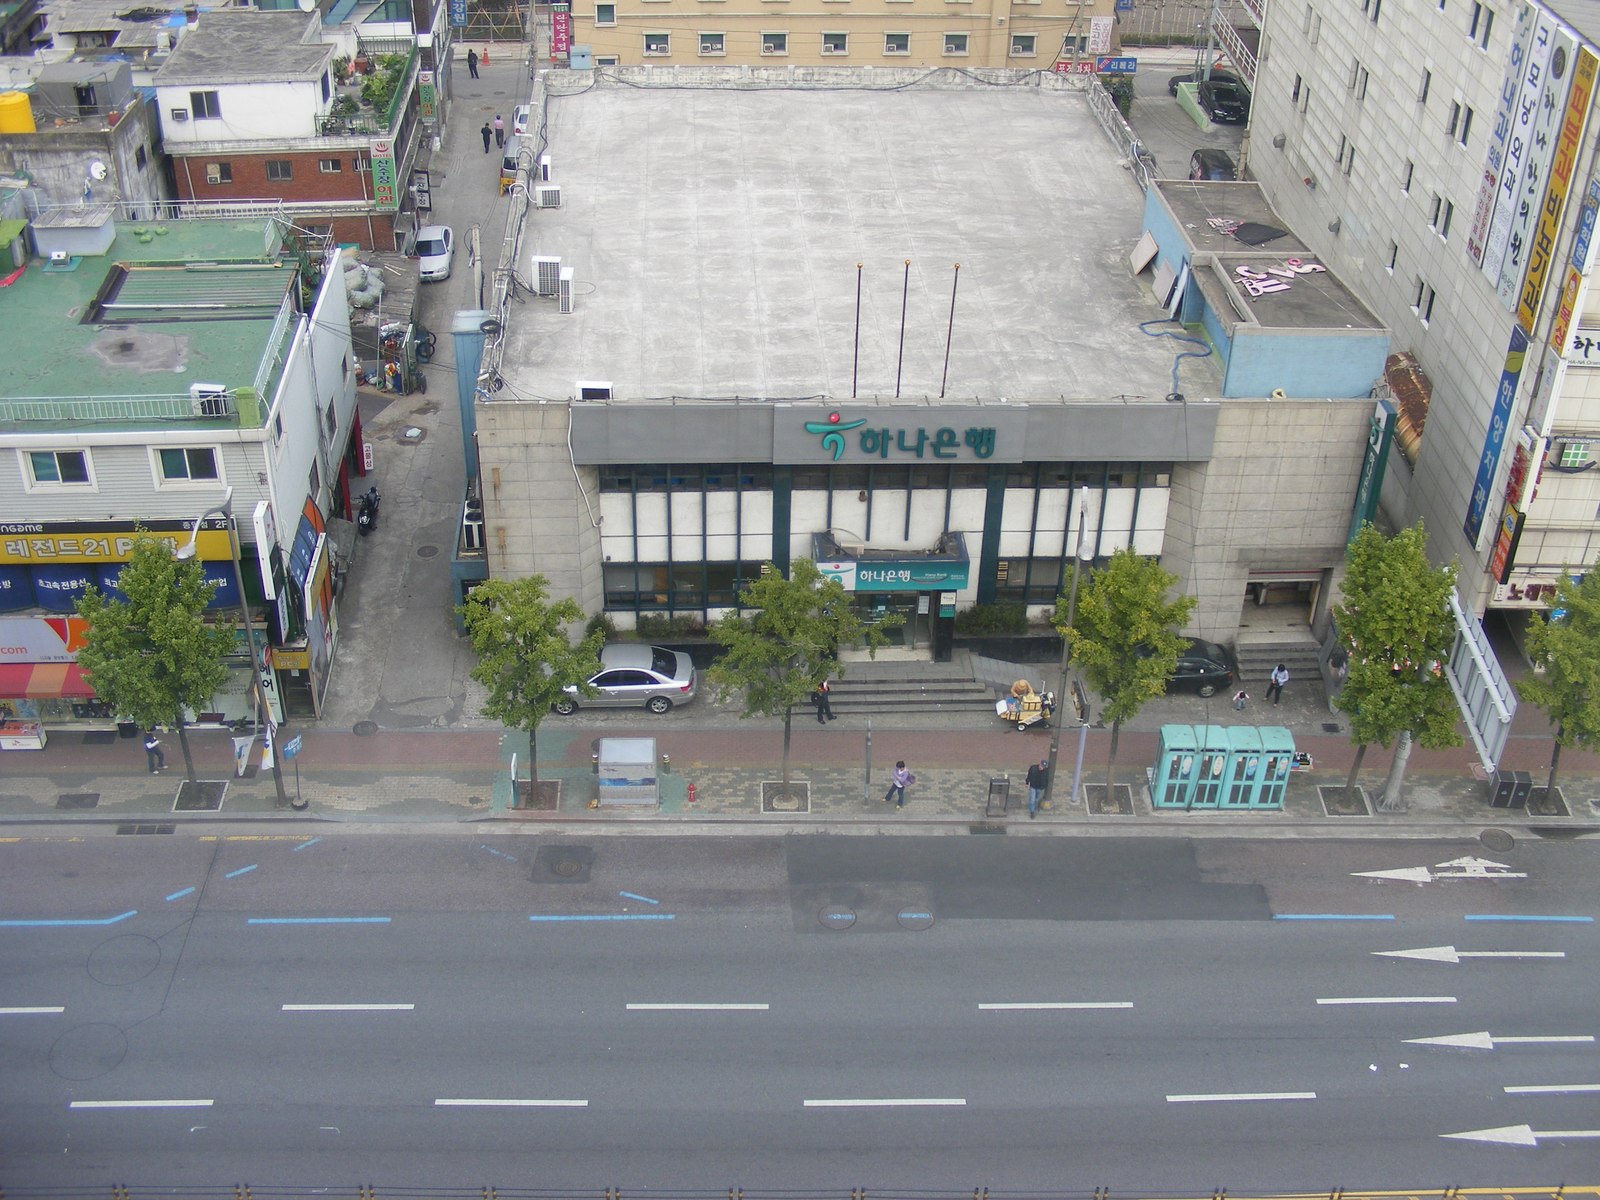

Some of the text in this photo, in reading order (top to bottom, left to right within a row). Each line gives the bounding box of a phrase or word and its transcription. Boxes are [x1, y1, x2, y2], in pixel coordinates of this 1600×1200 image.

[452, 0, 465, 22] 강원
[376, 160, 390, 184] 산수장
[1510, 86, 1555, 266] 하나한의원
[377, 185, 394, 205] 여관
[1524, 189, 1561, 317] 비뇨기과
[1573, 335, 1600, 358] 하
[859, 426, 997, 459] 하나은행
[1474, 378, 1514, 512] 한양치과
[5, 537, 111, 558] 레전드21
[860, 570, 911, 583] 하나은행
